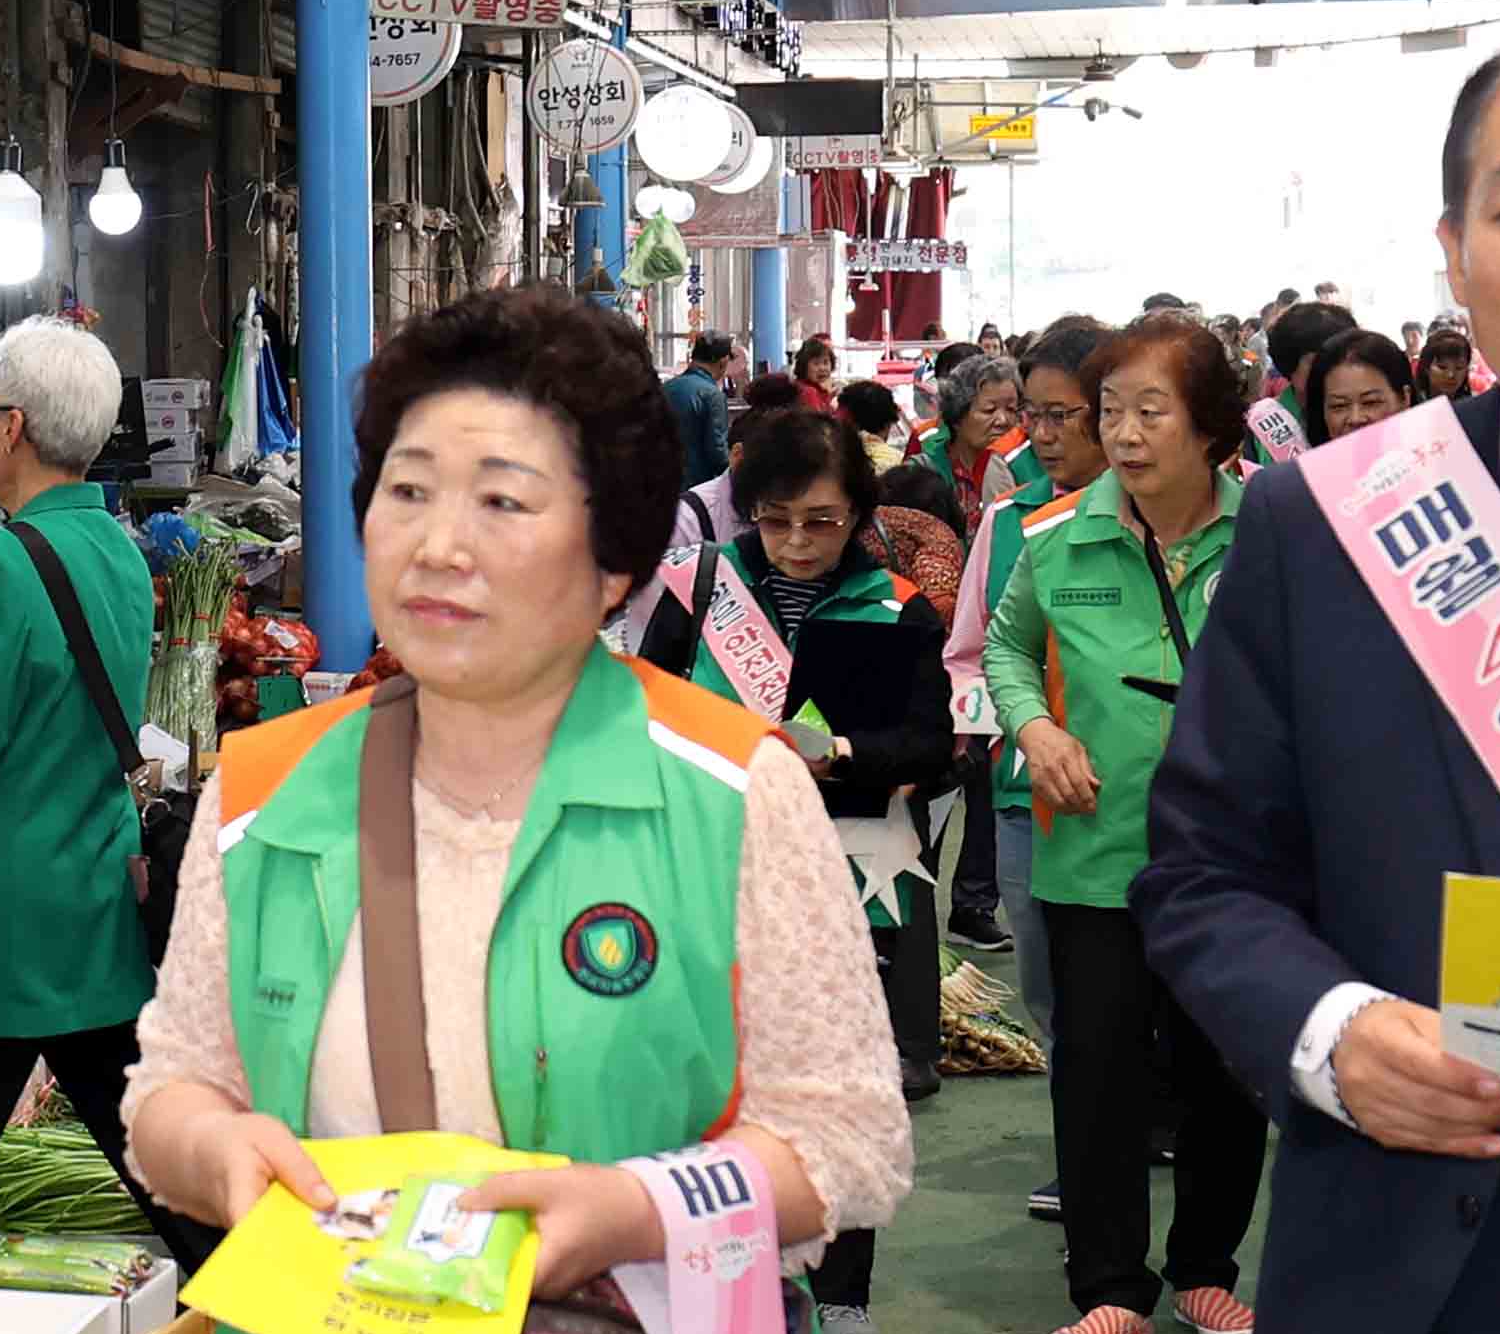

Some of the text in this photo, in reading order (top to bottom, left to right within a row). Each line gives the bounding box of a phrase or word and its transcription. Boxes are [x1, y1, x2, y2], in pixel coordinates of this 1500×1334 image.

[538, 79, 625, 112] 안성상회
[920, 241, 967, 265] 전문점
[1258, 412, 1293, 445] 매월
